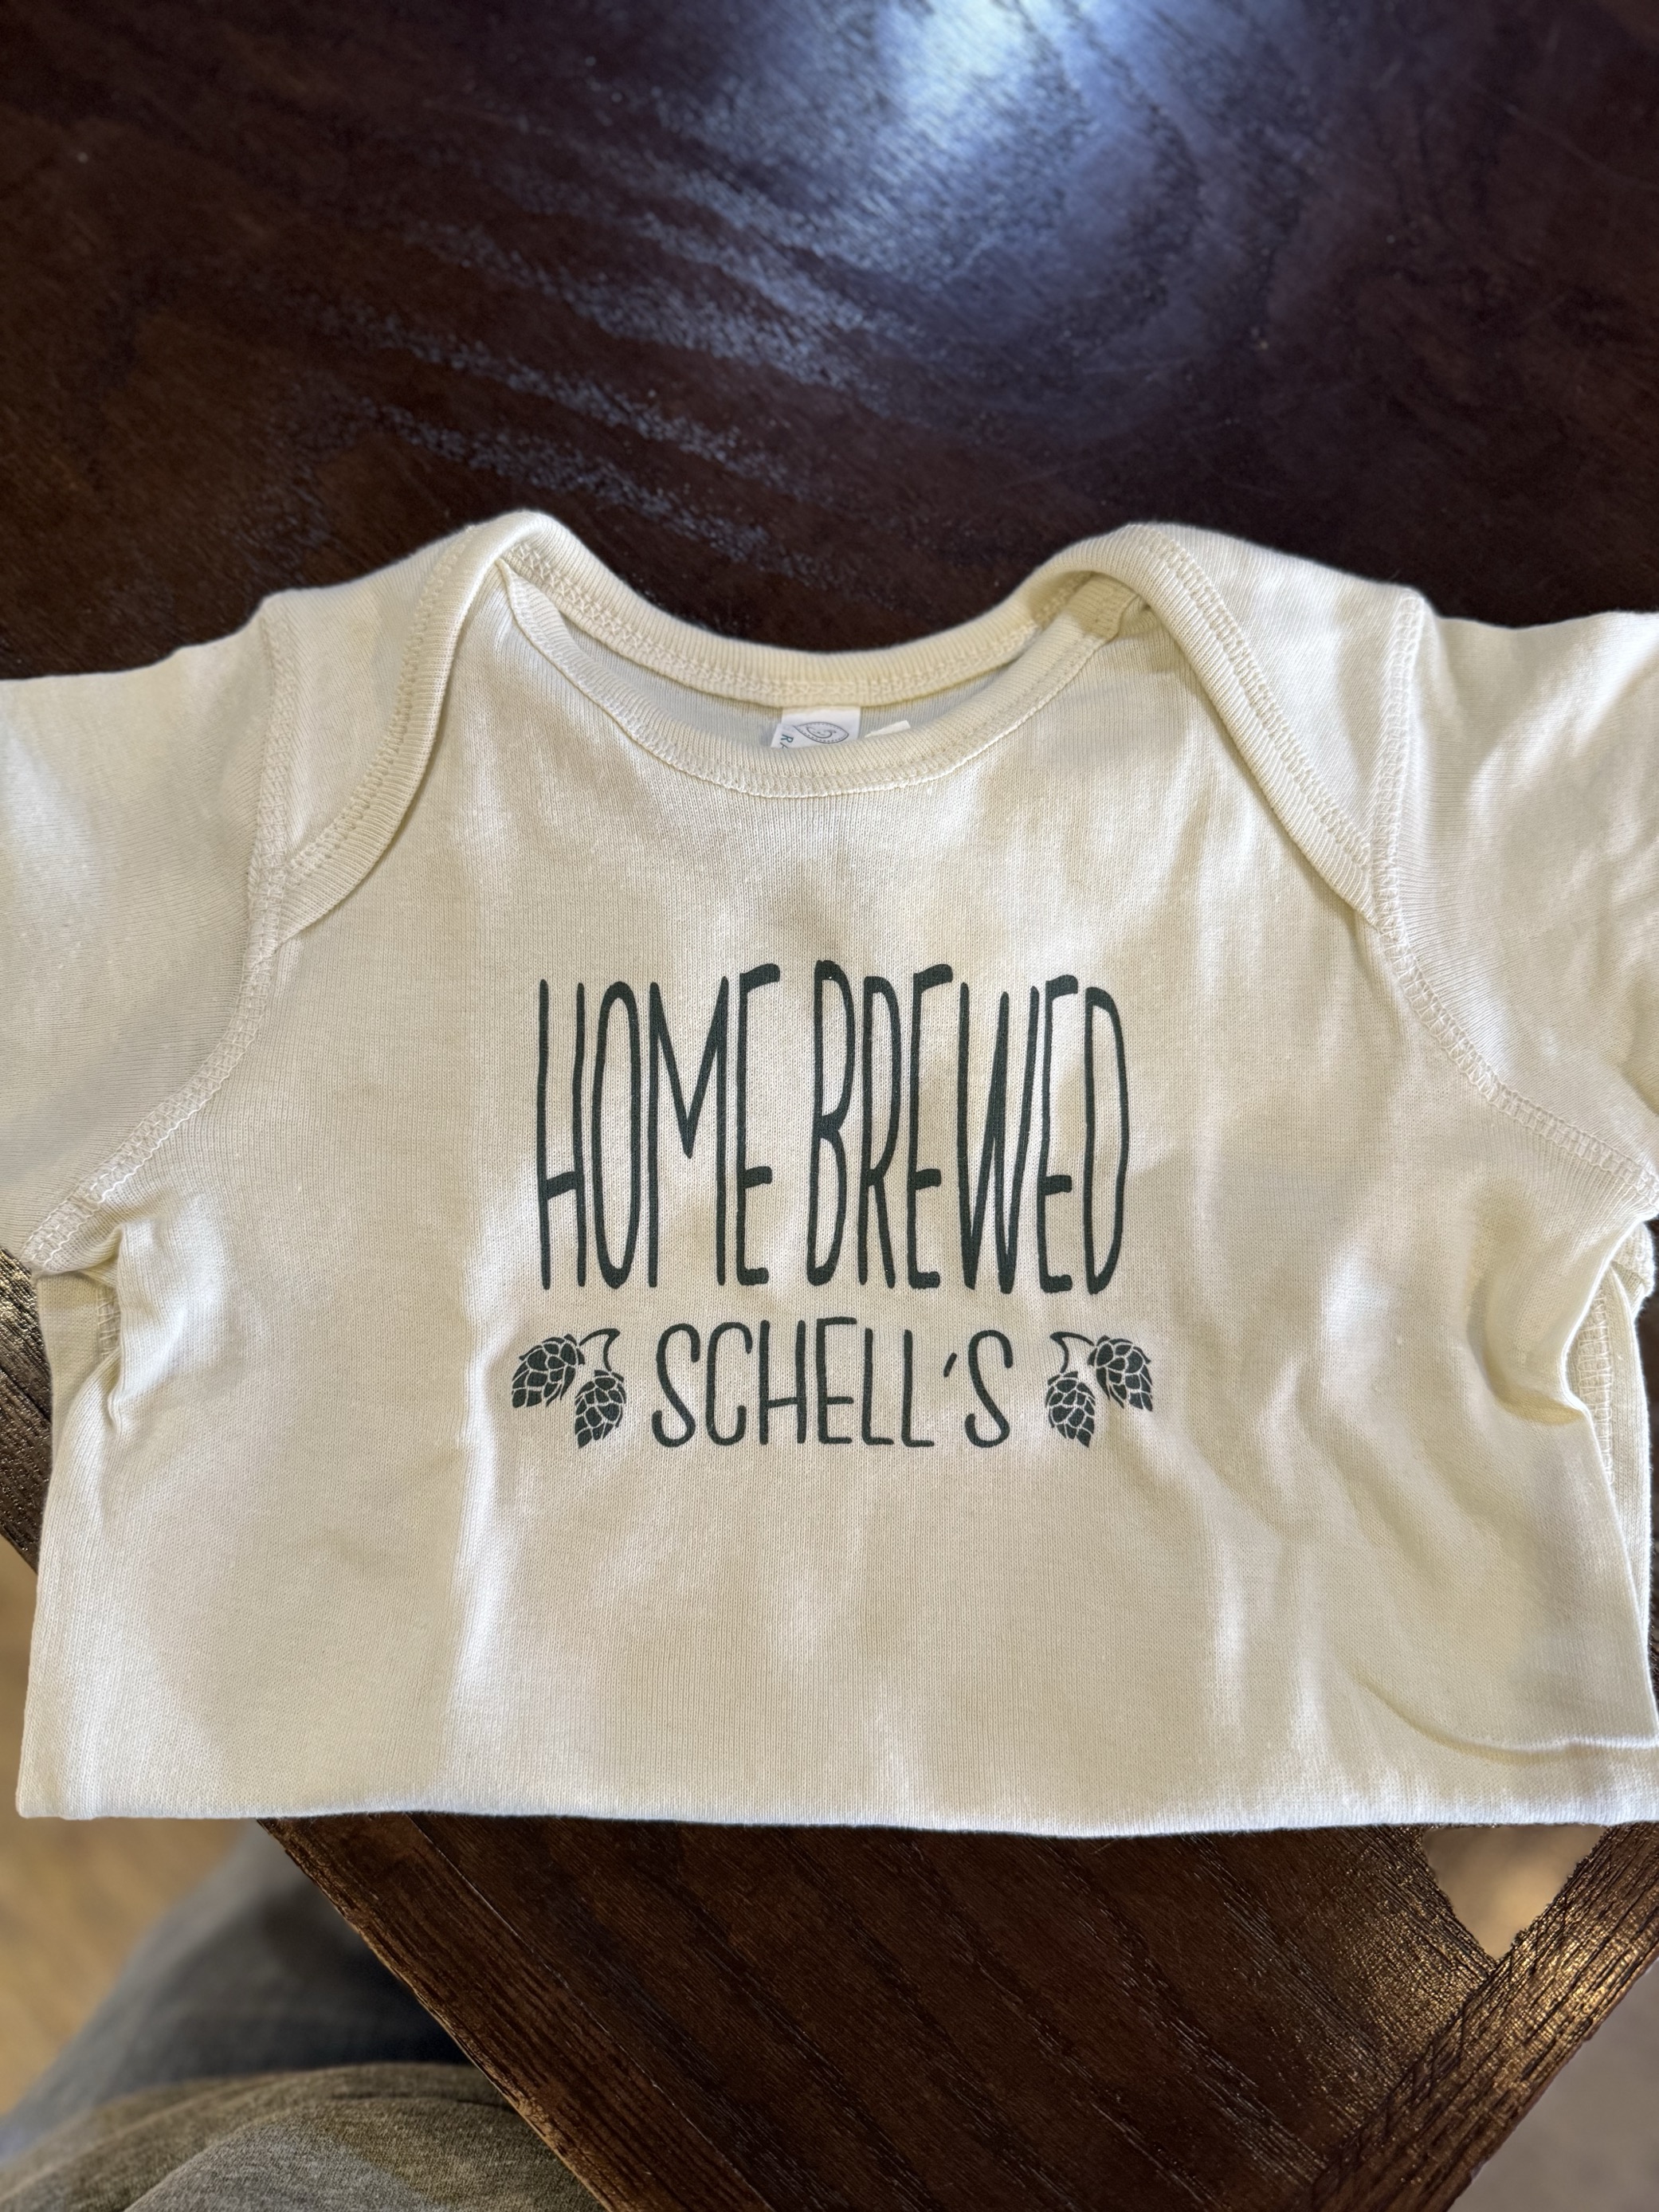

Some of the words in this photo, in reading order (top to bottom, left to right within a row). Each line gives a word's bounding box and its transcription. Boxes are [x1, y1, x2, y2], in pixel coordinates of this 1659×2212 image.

[536, 963, 781, 1291] HOME
[806, 959, 1130, 1296] BREWED
[650, 1316, 1014, 1449] SCHELL'S
